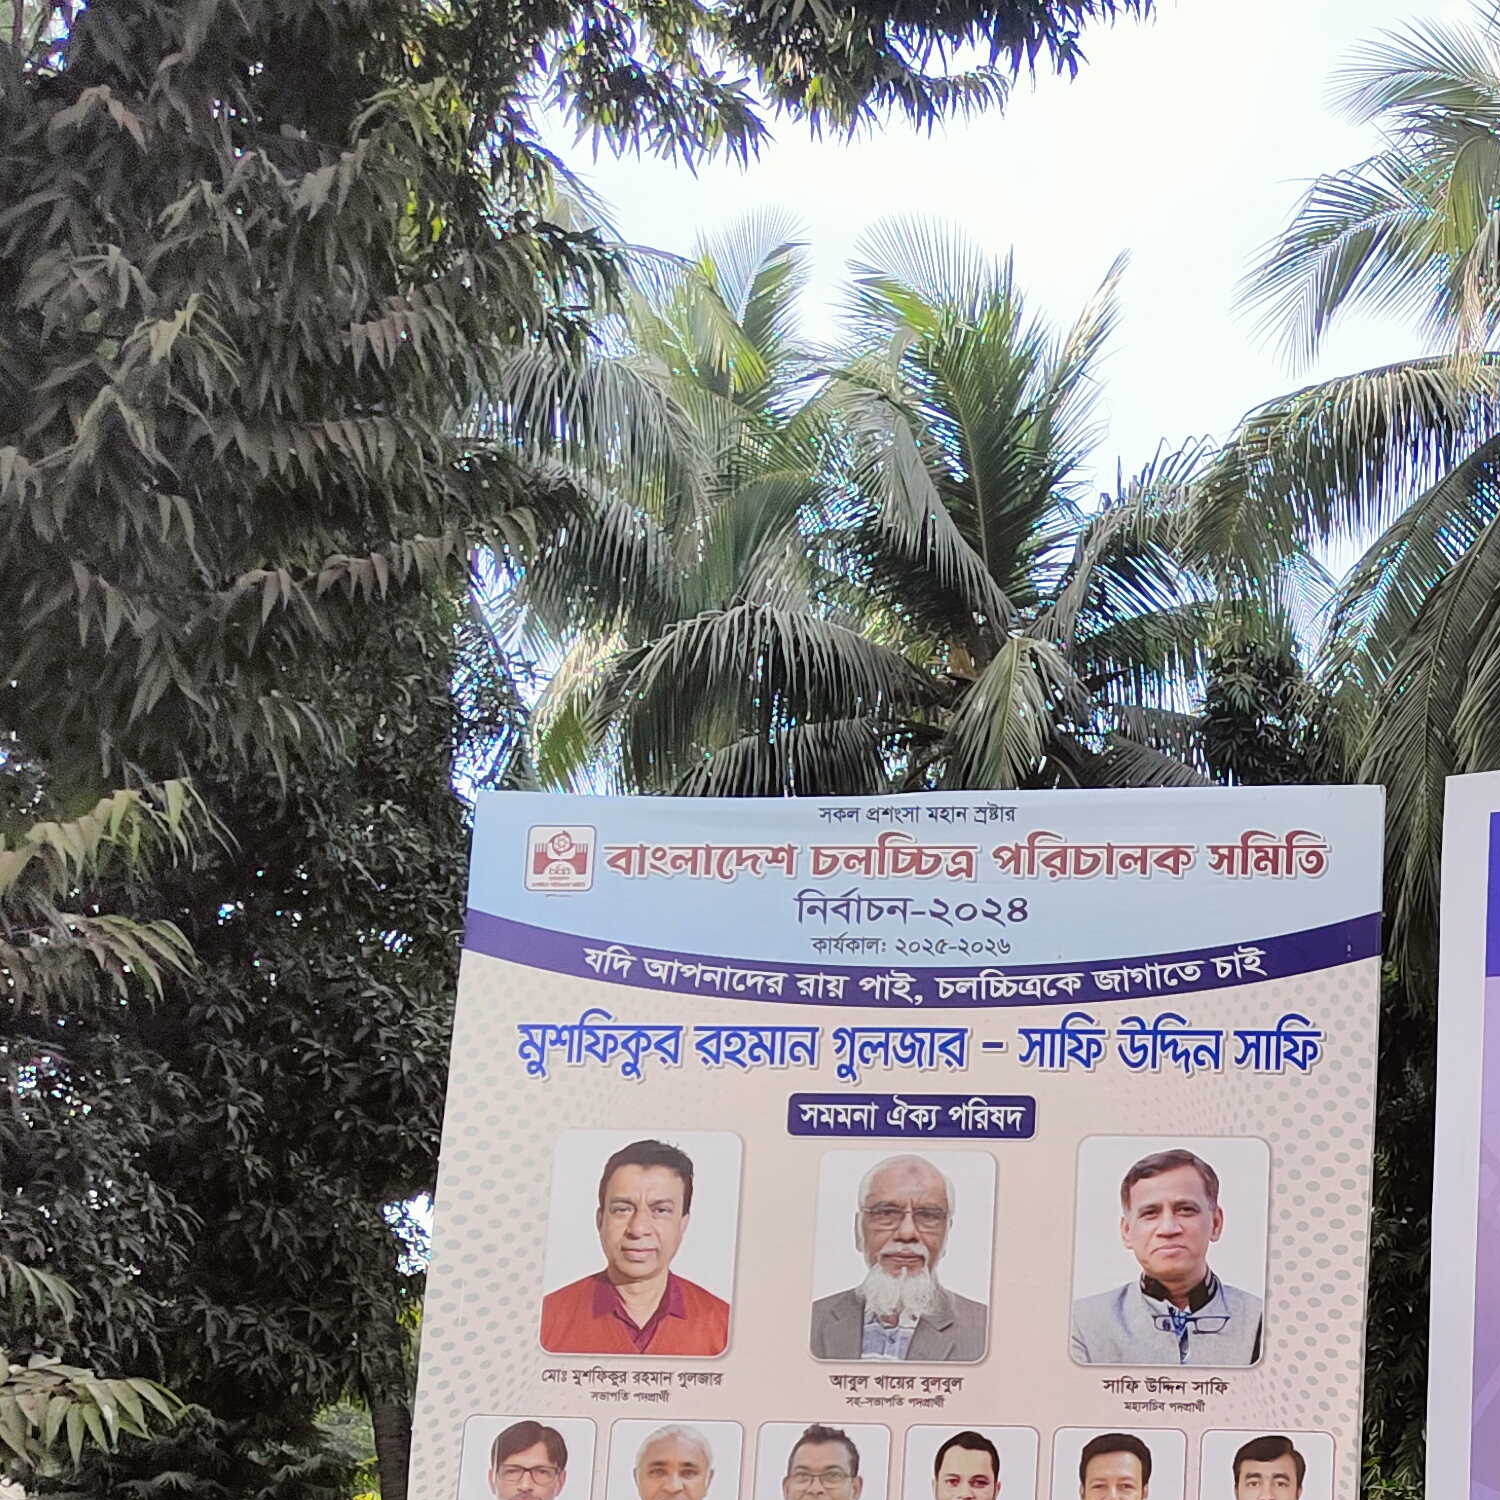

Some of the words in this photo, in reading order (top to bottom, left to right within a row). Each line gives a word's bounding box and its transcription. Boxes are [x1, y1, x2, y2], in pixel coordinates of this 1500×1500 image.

[819, 806, 860, 824] সকল
[927, 807, 967, 824] মহান
[603, 843, 798, 881] বাংলাদেশ
[810, 831, 978, 879] চলচ্চিত্র
[993, 831, 1196, 879] পরিচালক
[1206, 830, 1329, 879] সমিতি
[794, 887, 1028, 927] নির্বাচন-২০২৪
[583, 945, 637, 979] যদি
[643, 957, 789, 996] আপনাদের
[797, 973, 850, 1000] রায়
[858, 972, 924, 1006] পাই,
[933, 969, 1086, 1000] চলচ্চিত্রকে
[1091, 961, 1206, 994] জাগাতে
[1210, 945, 1269, 979] চাই
[517, 1008, 683, 1079] মুশফিকুর
[694, 1024, 820, 1069] রহমান
[831, 1025, 969, 1081] গুলজার
[1017, 1012, 1107, 1071] সাফি
[1116, 1012, 1224, 1075] উদ্দিন
[1233, 1013, 1322, 1072] সাফি
[799, 1101, 878, 1131] সমমনা
[886, 1094, 939, 1132] ঐক্য
[948, 1097, 1026, 1132] পরিষদ
[631, 1370, 674, 1387] রহমান
[1102, 1377, 1139, 1394] সাফি
[1192, 1377, 1230, 1396] সাফি
